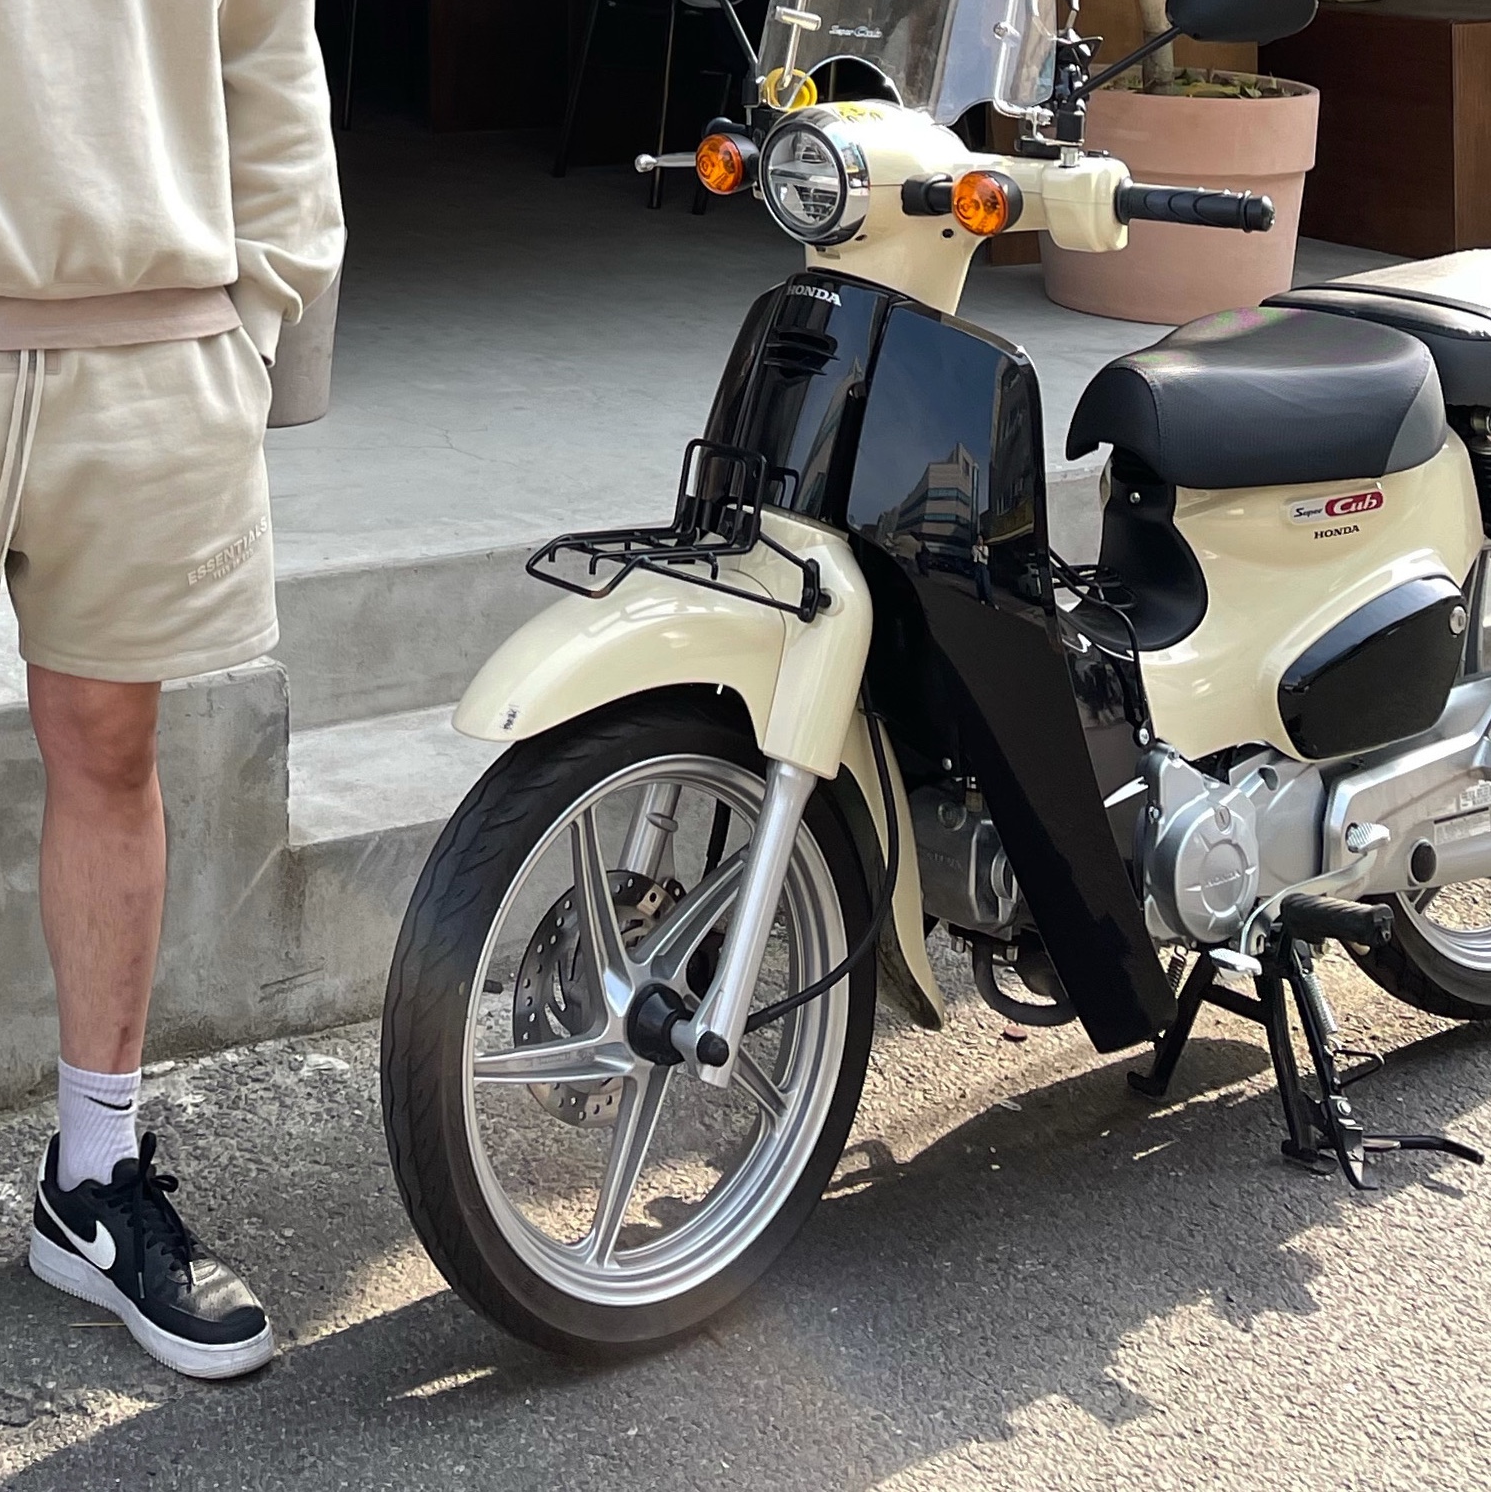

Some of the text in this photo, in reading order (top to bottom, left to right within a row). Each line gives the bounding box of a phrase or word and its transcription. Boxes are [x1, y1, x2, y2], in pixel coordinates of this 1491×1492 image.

[786, 284, 843, 308] HONDA
[1293, 493, 1378, 519] Super Cub
[1313, 524, 1361, 540] HONDA
[187, 515, 268, 587] ESSENTIALS
